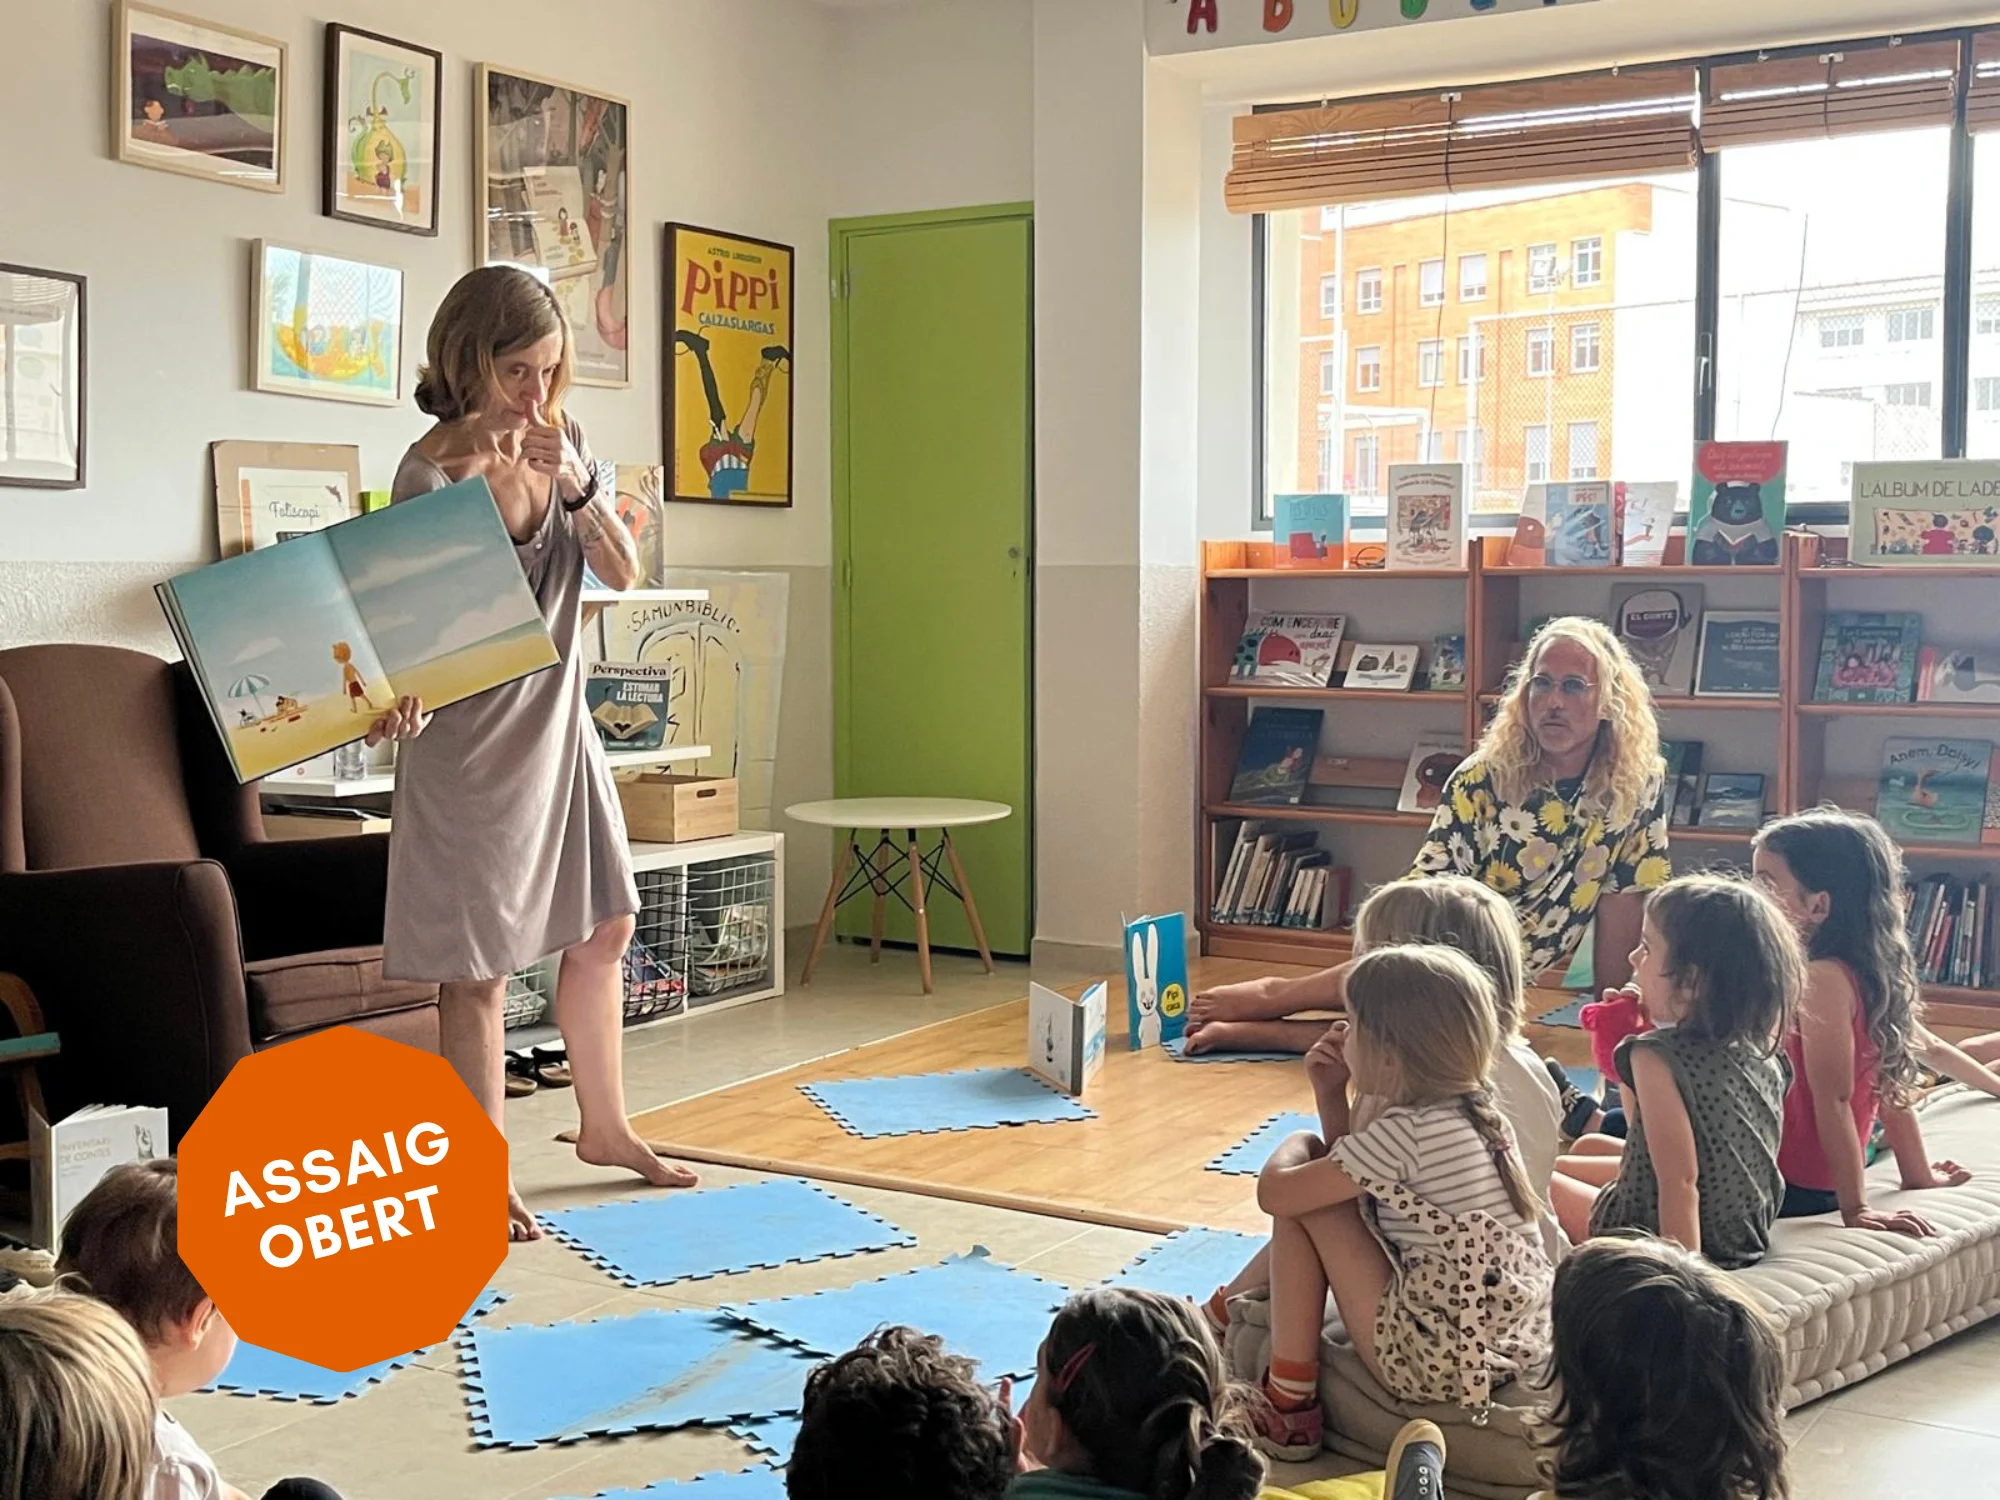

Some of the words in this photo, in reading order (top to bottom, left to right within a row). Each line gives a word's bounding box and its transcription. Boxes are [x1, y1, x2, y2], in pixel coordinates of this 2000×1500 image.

[698, 312, 776, 335] CALZASLARGAS
[1933, 480, 1955, 497] DE
[268, 501, 321, 525] Foliscopi
[593, 664, 667, 677] Perspectiva
[616, 690, 627, 701] LA
